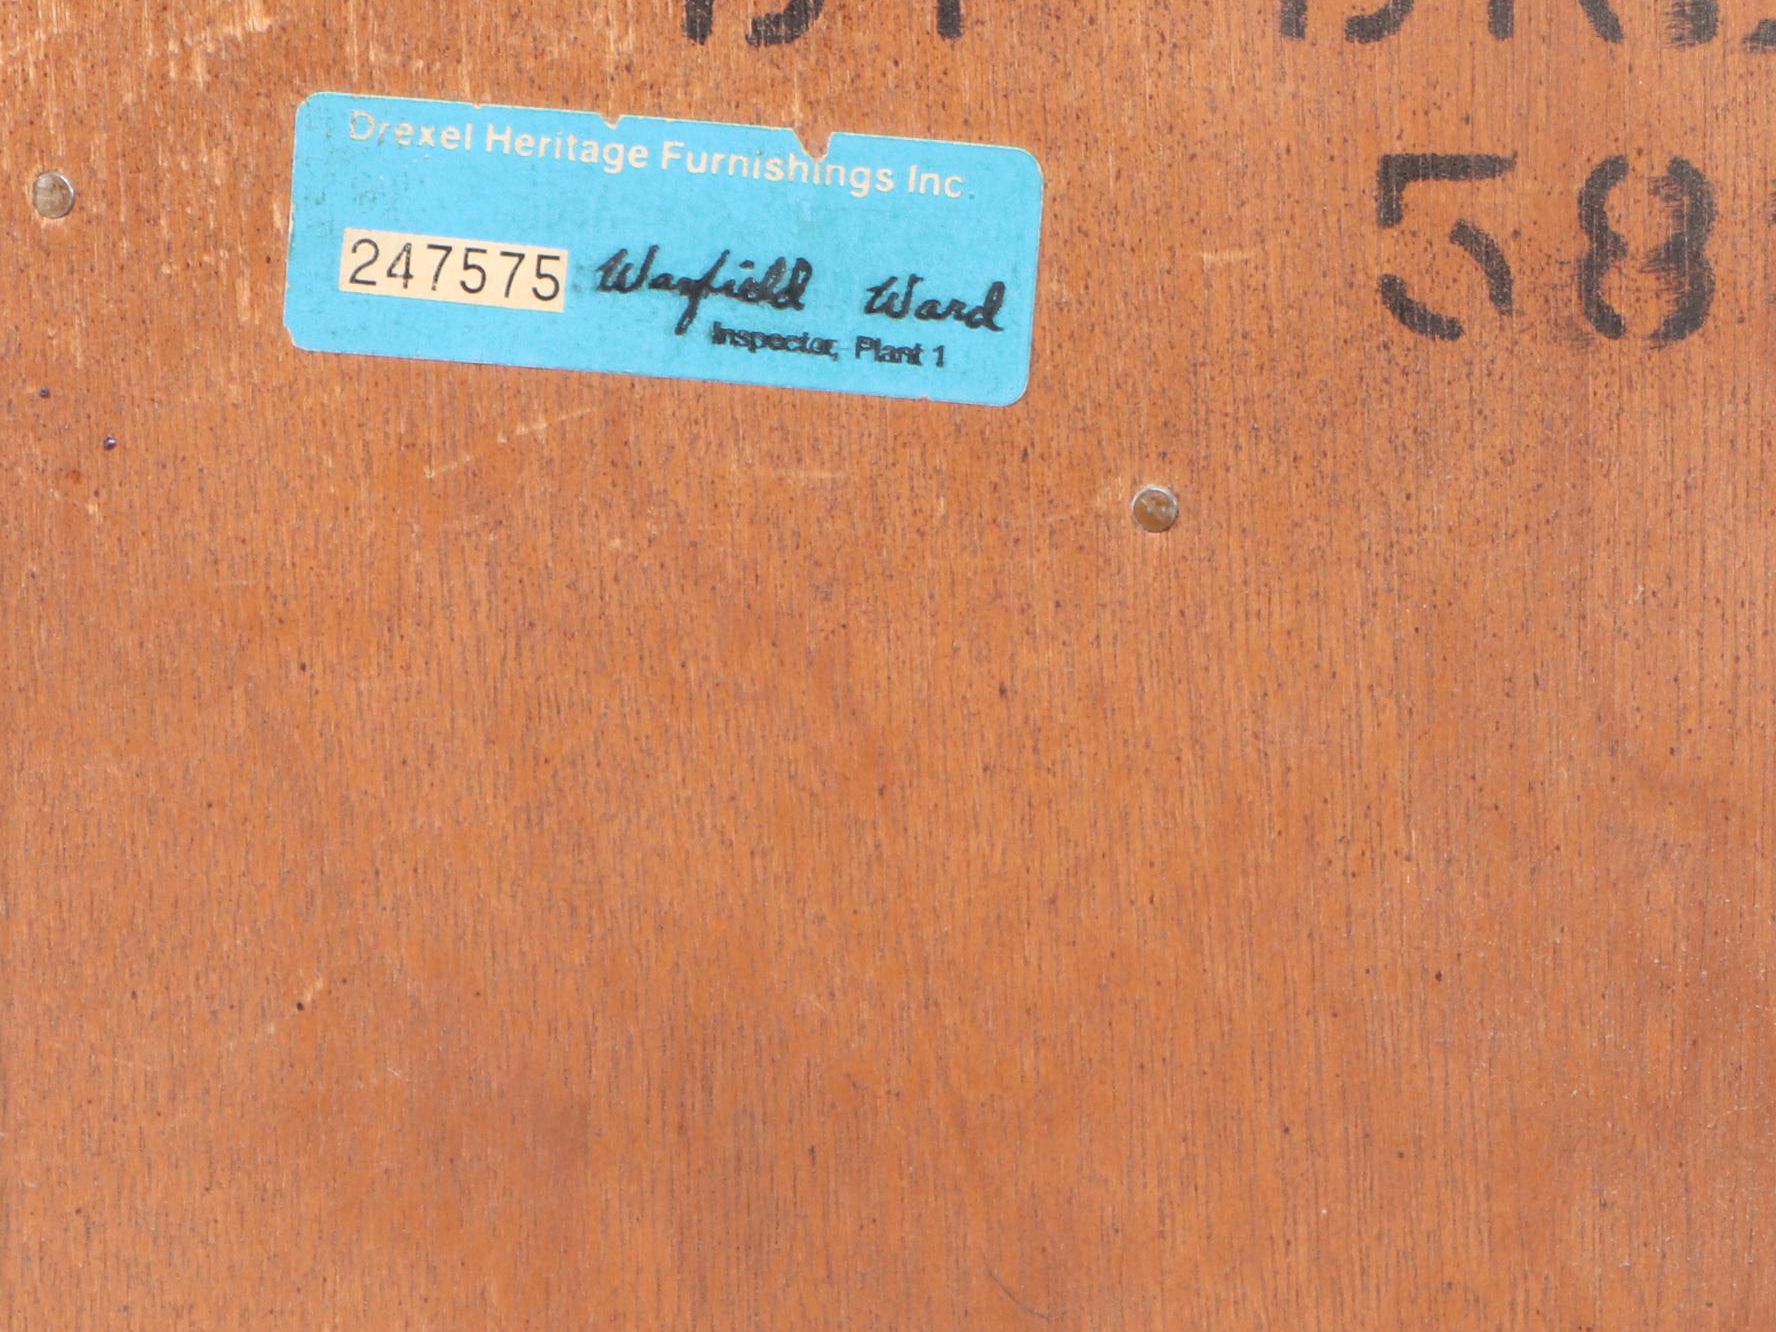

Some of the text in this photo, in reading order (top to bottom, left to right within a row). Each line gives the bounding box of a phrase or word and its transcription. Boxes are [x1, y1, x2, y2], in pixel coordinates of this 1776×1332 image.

[349, 110, 473, 152] Drexel
[485, 124, 648, 174] Heritage
[661, 140, 895, 199] Furnishings
[350, 238, 560, 302] 247575
[864, 273, 1005, 332] Ward
[712, 321, 945, 368] Inspector, Plant 1
